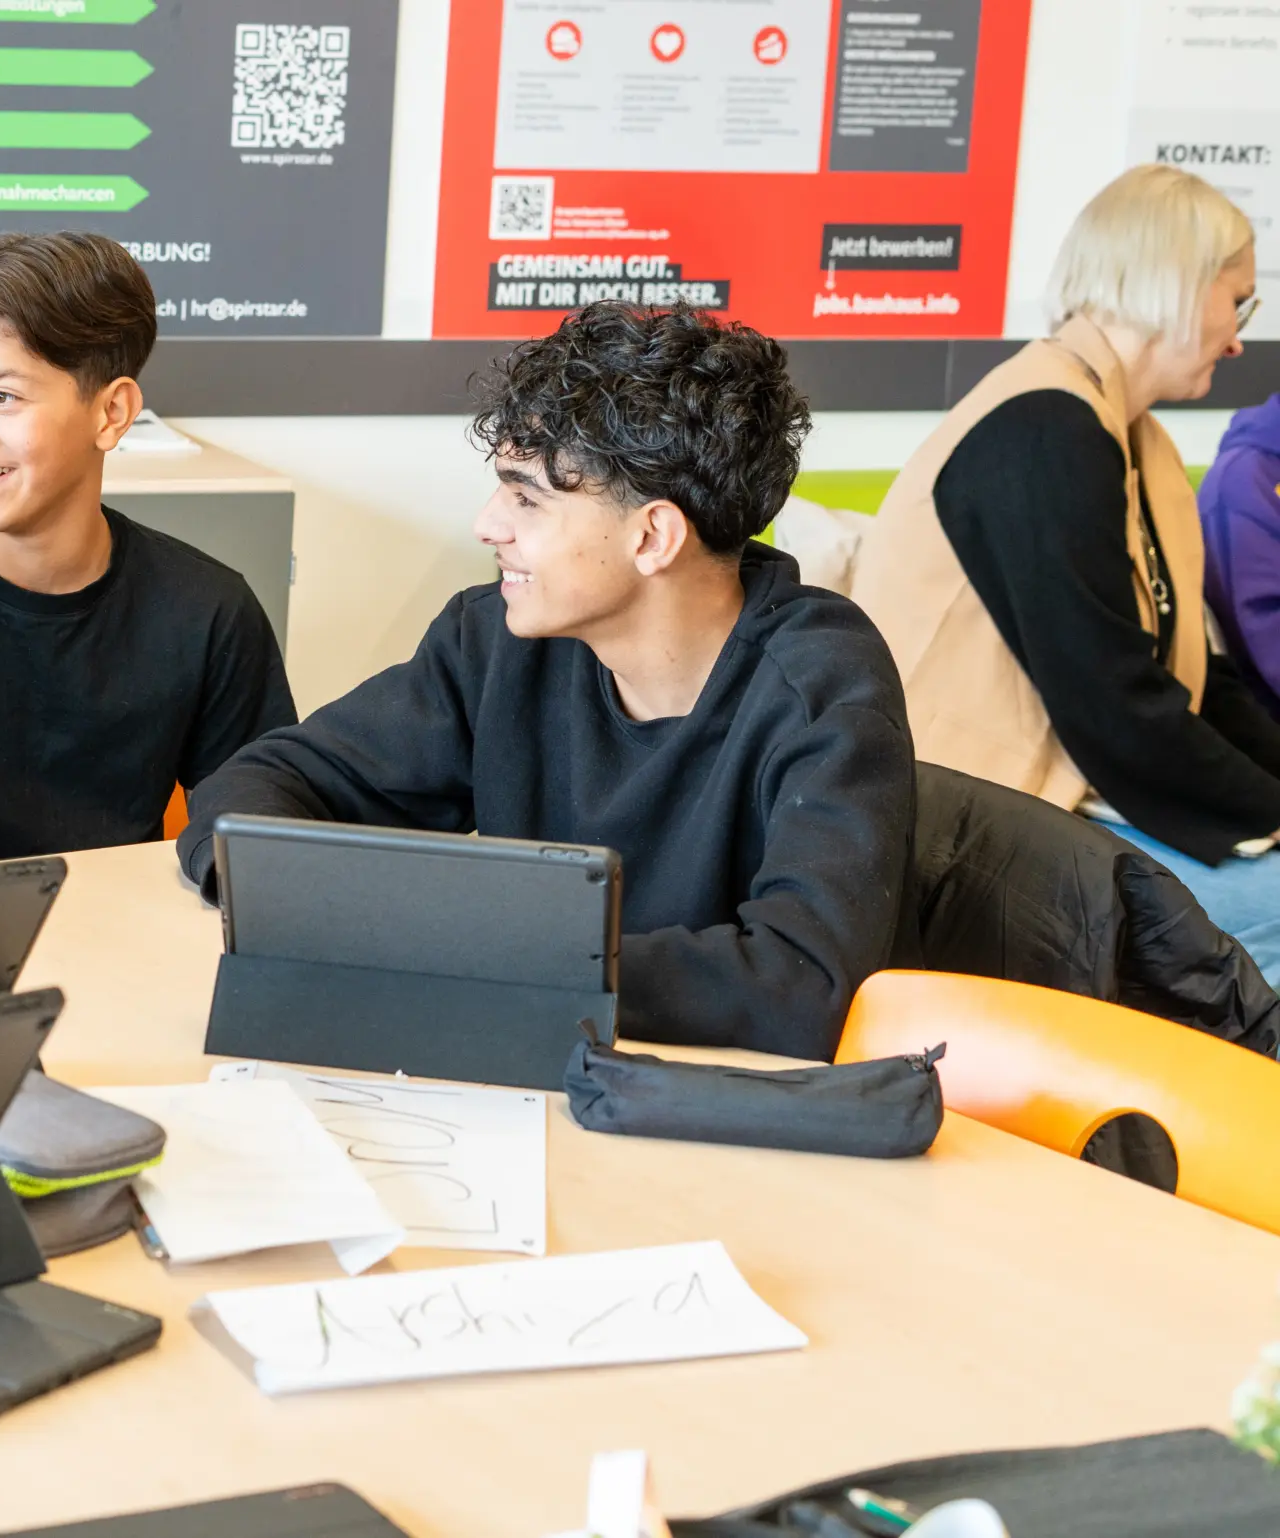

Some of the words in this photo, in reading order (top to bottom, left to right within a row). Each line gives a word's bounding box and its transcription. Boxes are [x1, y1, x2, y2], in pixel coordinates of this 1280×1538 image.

[1155, 145, 1272, 166] KONTAKT:
[497, 254, 622, 279] GEMEINSAM
[625, 254, 674, 279] GUT.
[494, 281, 536, 306] MIT
[538, 282, 577, 306] DIR
[579, 282, 638, 306] NOCH
[641, 283, 722, 306] BESSER.
[190, 297, 308, 321] hr@spirstar.de
